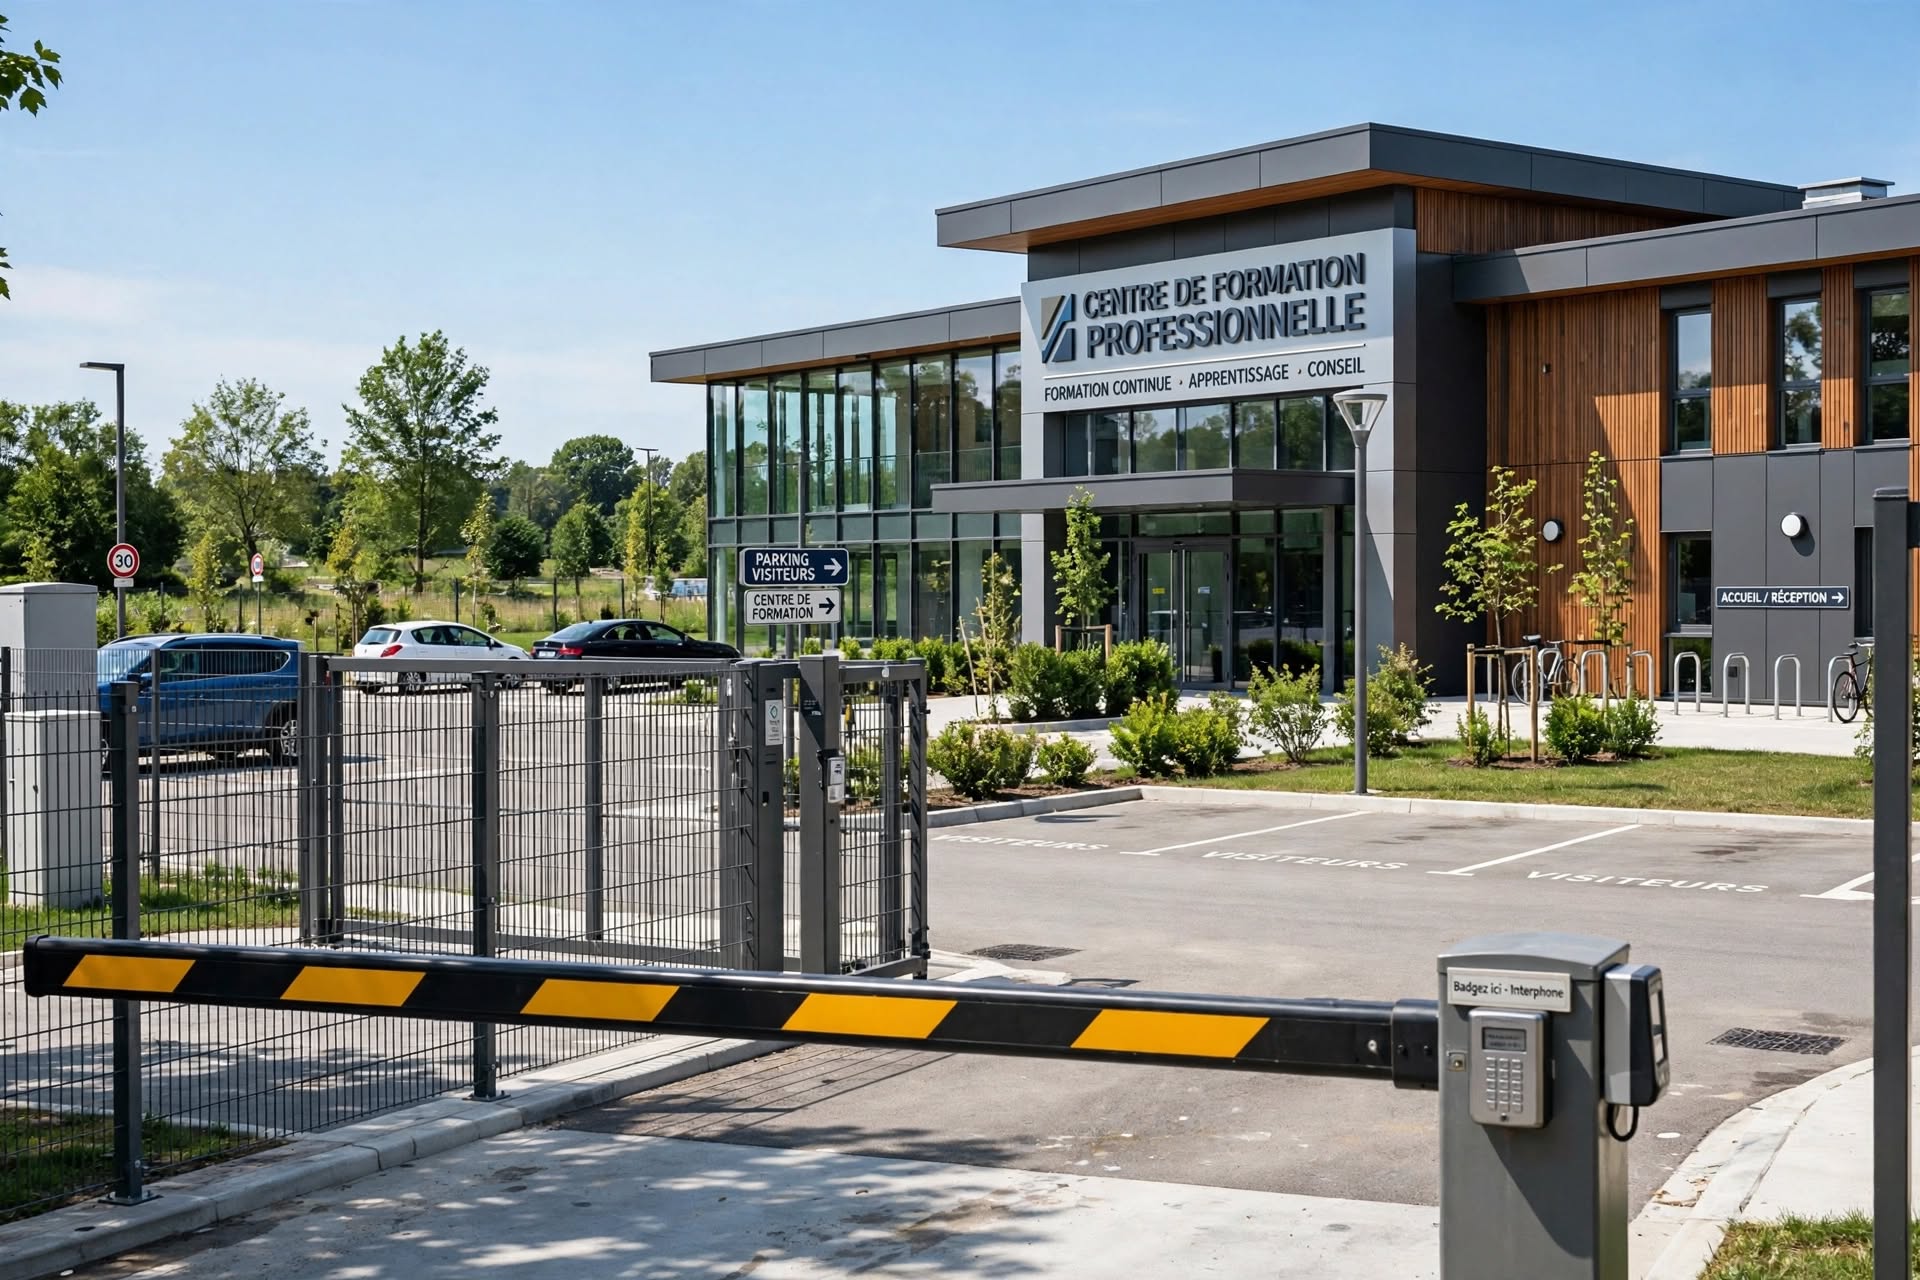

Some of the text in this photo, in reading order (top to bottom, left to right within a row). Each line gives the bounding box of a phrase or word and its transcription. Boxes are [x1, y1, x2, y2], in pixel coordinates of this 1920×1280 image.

[1083, 252, 1365, 319] CENTRE DE FORMATION
[1087, 292, 1366, 358] PROFESSIONNELLE
[1044, 380, 1109, 402] FORMATION
[1113, 375, 1172, 396] CONTINUE
[1189, 363, 1290, 389] APPRENTISSAGE
[1307, 357, 1365, 377] CONSEIL
[115, 553, 133, 569] 30
[755, 552, 809, 566] PARKING
[752, 567, 815, 581] VISITEURS
[753, 593, 811, 606] CENTRE DE
[1721, 588, 1827, 604] ACCUEIL / RÉCEPTION
[752, 607, 813, 620] FORMATION
[930, 835, 1109, 850] VISITEURS
[1201, 851, 1409, 870] VISITEURS
[1526, 871, 1769, 893] VISITEURS
[1453, 981, 1488, 996] Badgez
[1490, 982, 1502, 995] ici
[1510, 984, 1564, 999] Interphone
